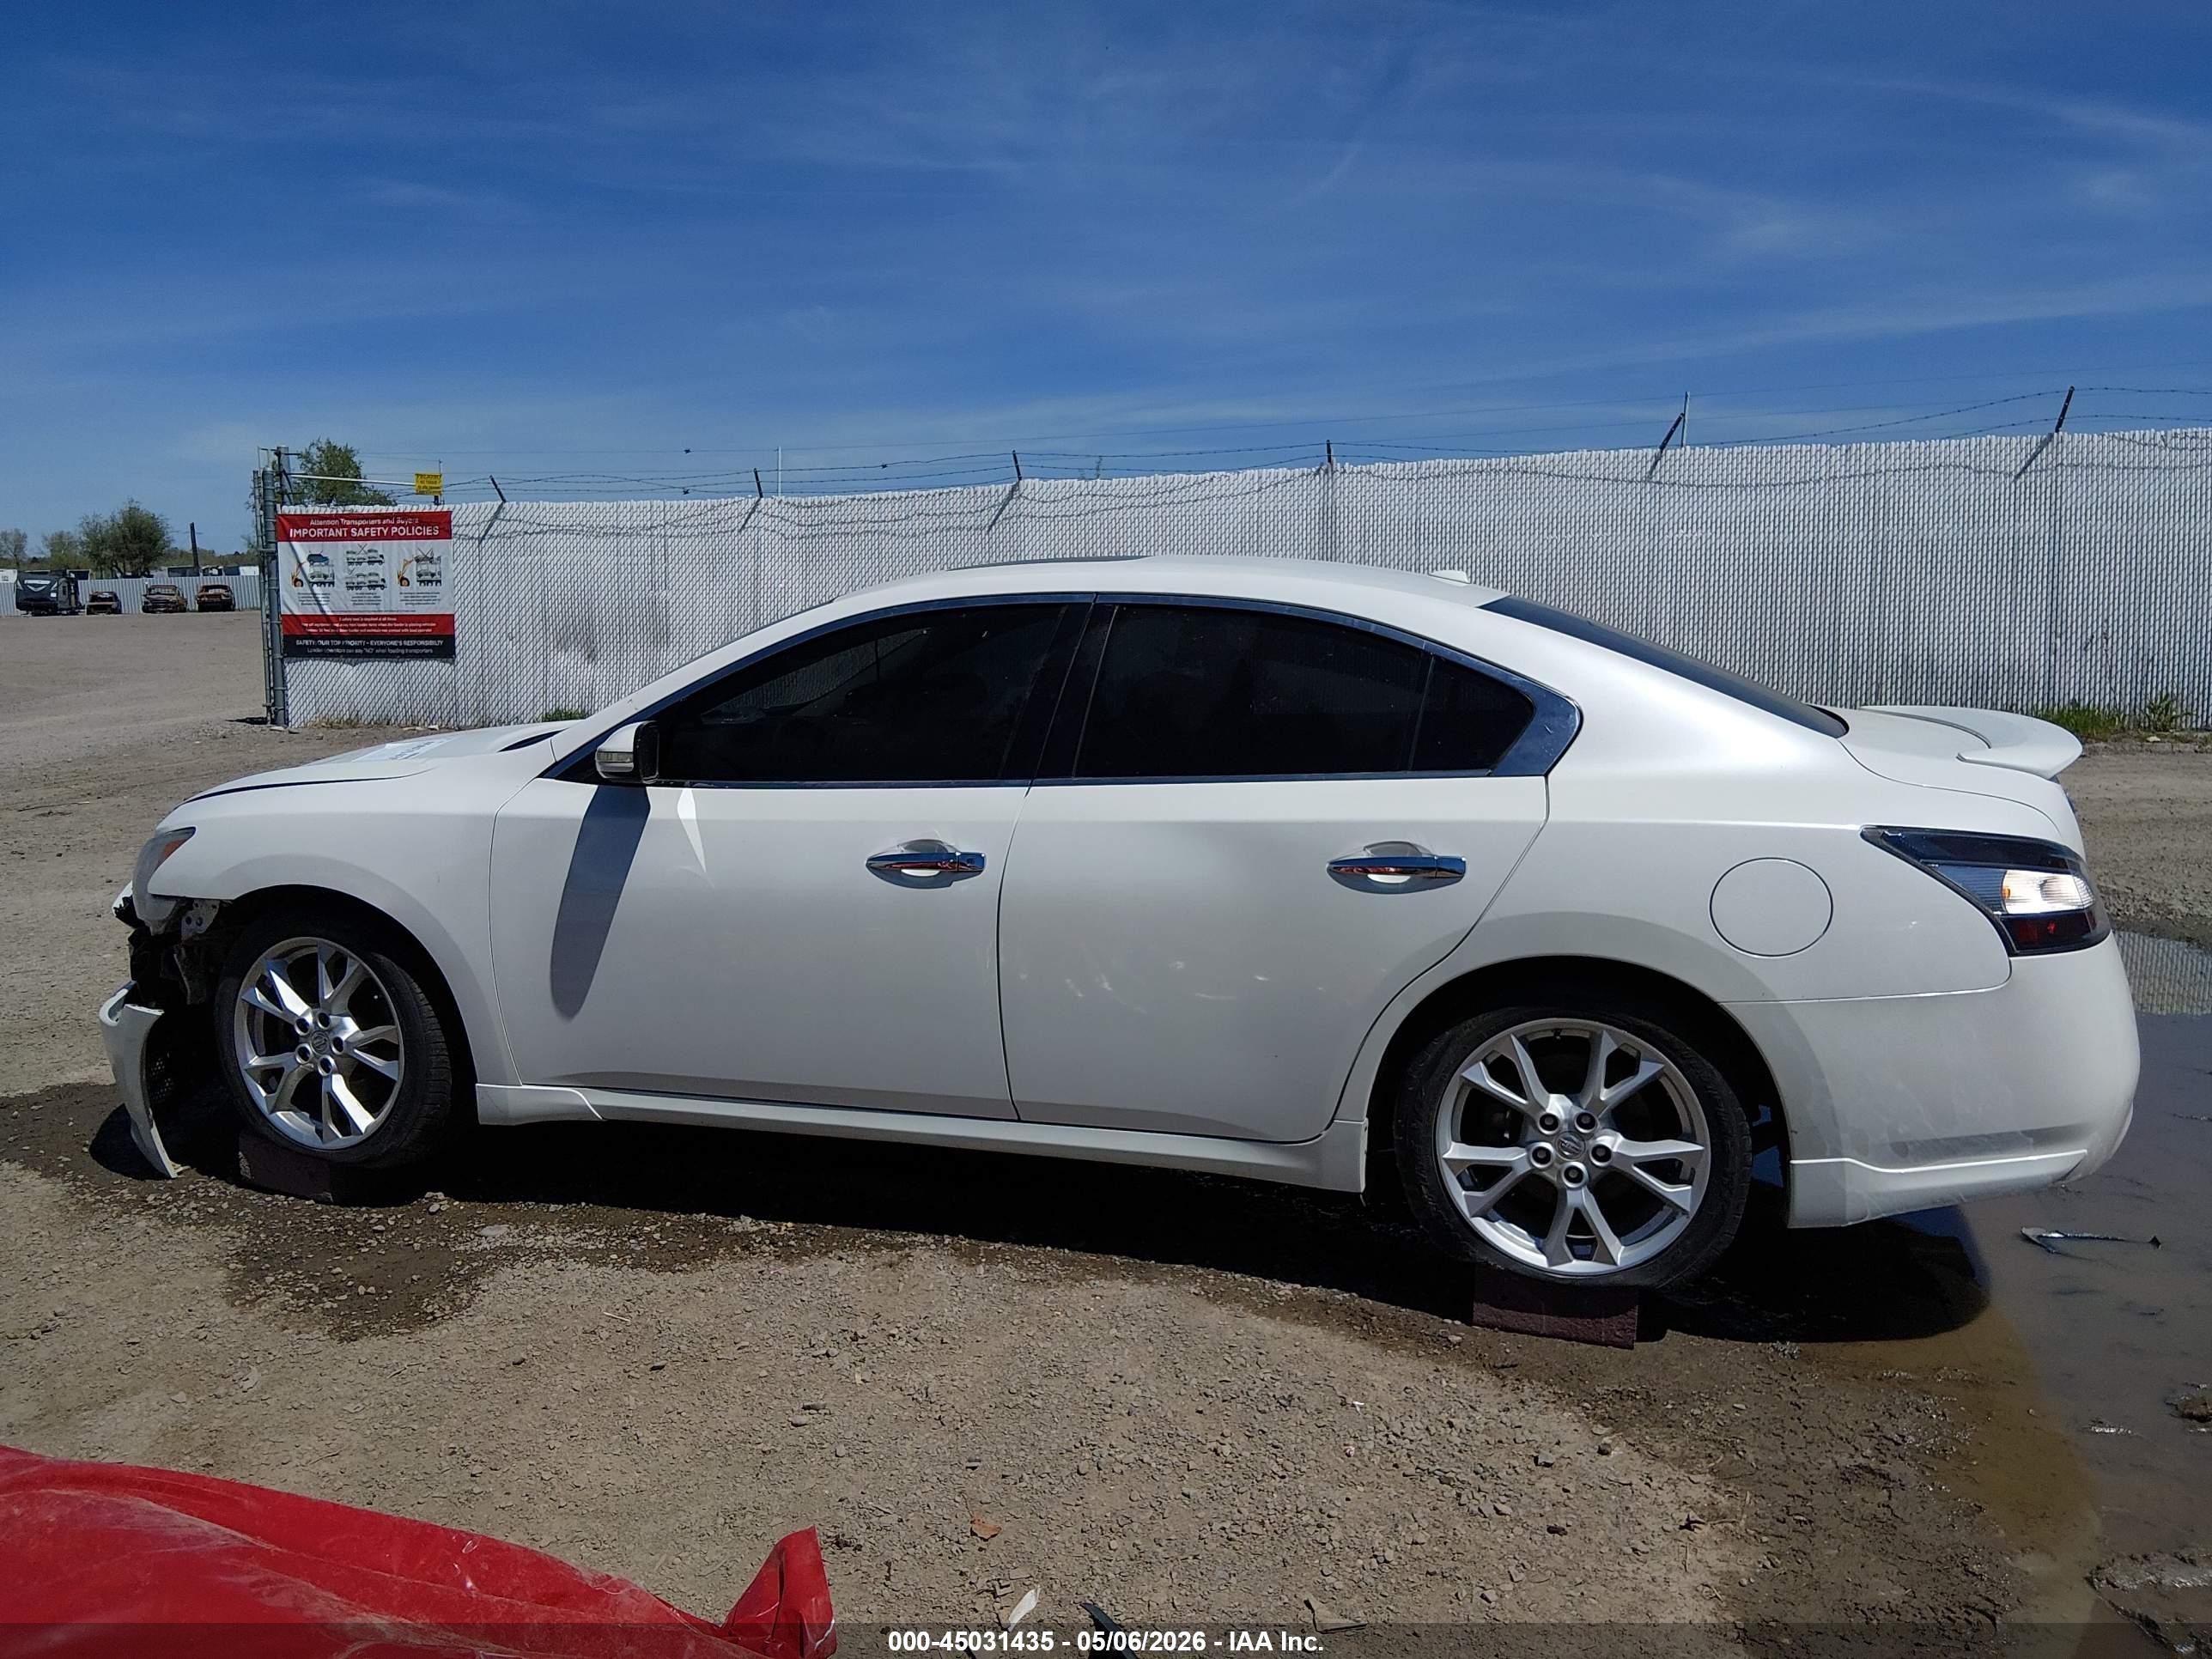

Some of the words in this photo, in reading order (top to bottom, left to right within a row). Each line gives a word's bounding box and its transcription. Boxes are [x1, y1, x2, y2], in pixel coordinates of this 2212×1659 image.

[340, 518, 381, 526] Transporters
[289, 528, 349, 538] IMPORTANT
[350, 527, 389, 538] SAFETY
[391, 526, 440, 537] POLICIES
